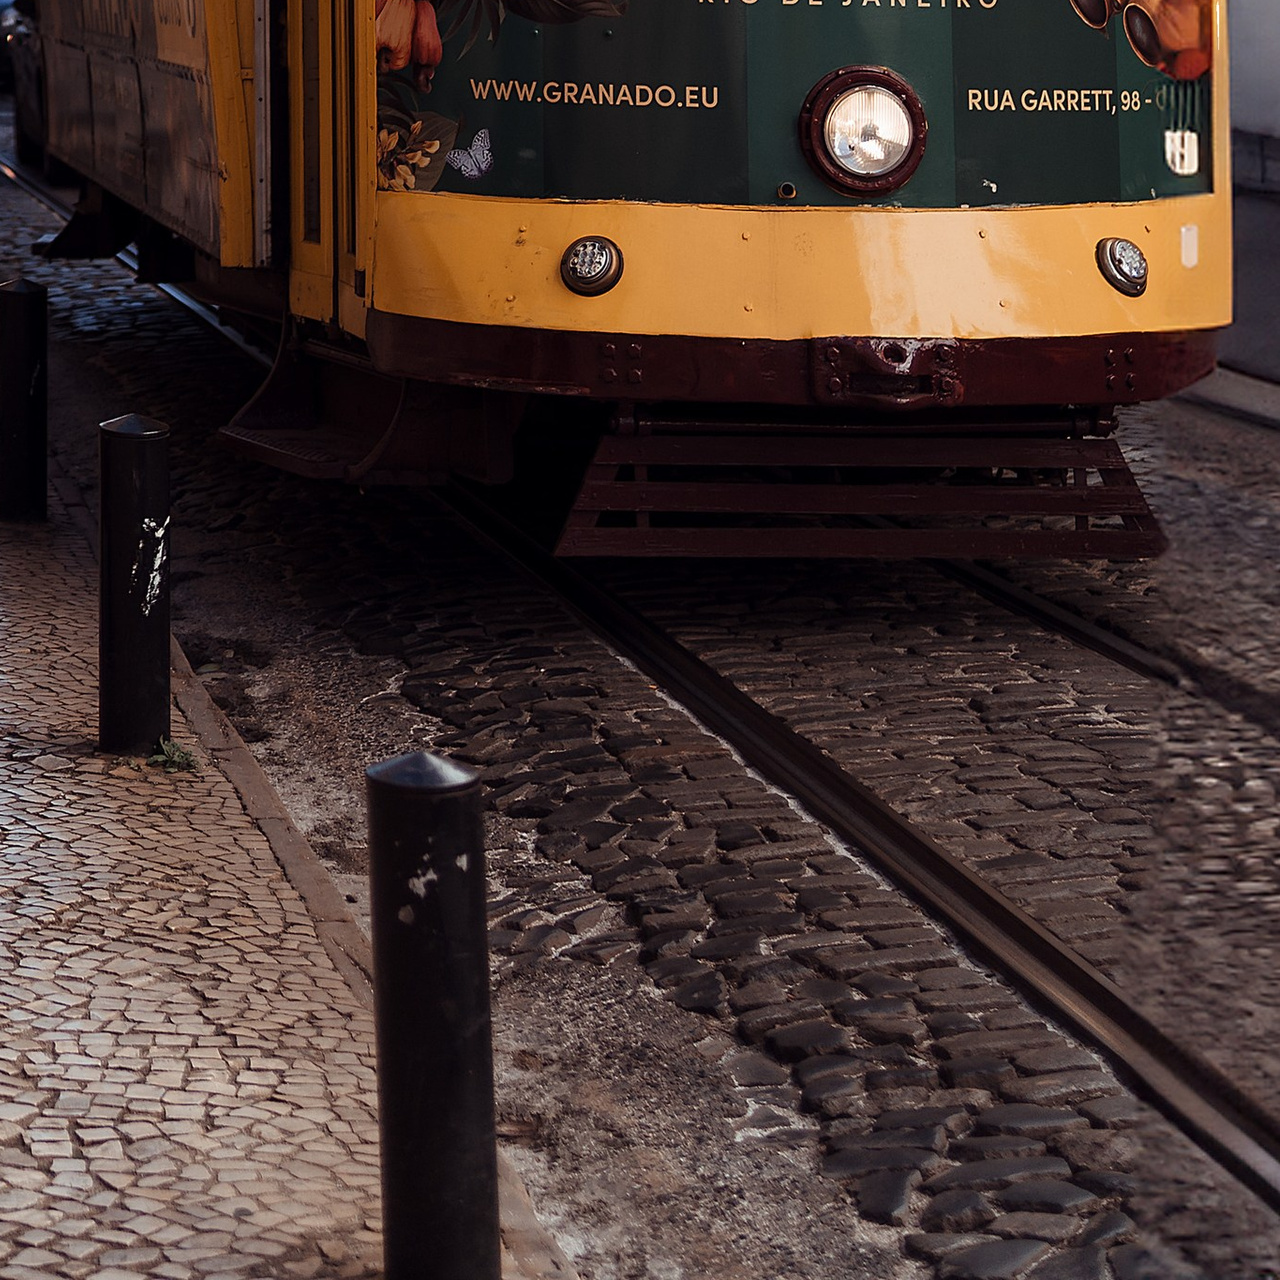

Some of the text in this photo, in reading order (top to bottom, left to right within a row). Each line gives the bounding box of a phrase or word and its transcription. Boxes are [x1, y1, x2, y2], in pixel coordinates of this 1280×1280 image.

[469, 78, 719, 109] WWW.GRANADO.EU
[967, 89, 1016, 111] RUA
[1020, 89, 1117, 116] GARRETT,
[1120, 90, 1141, 112] 98
